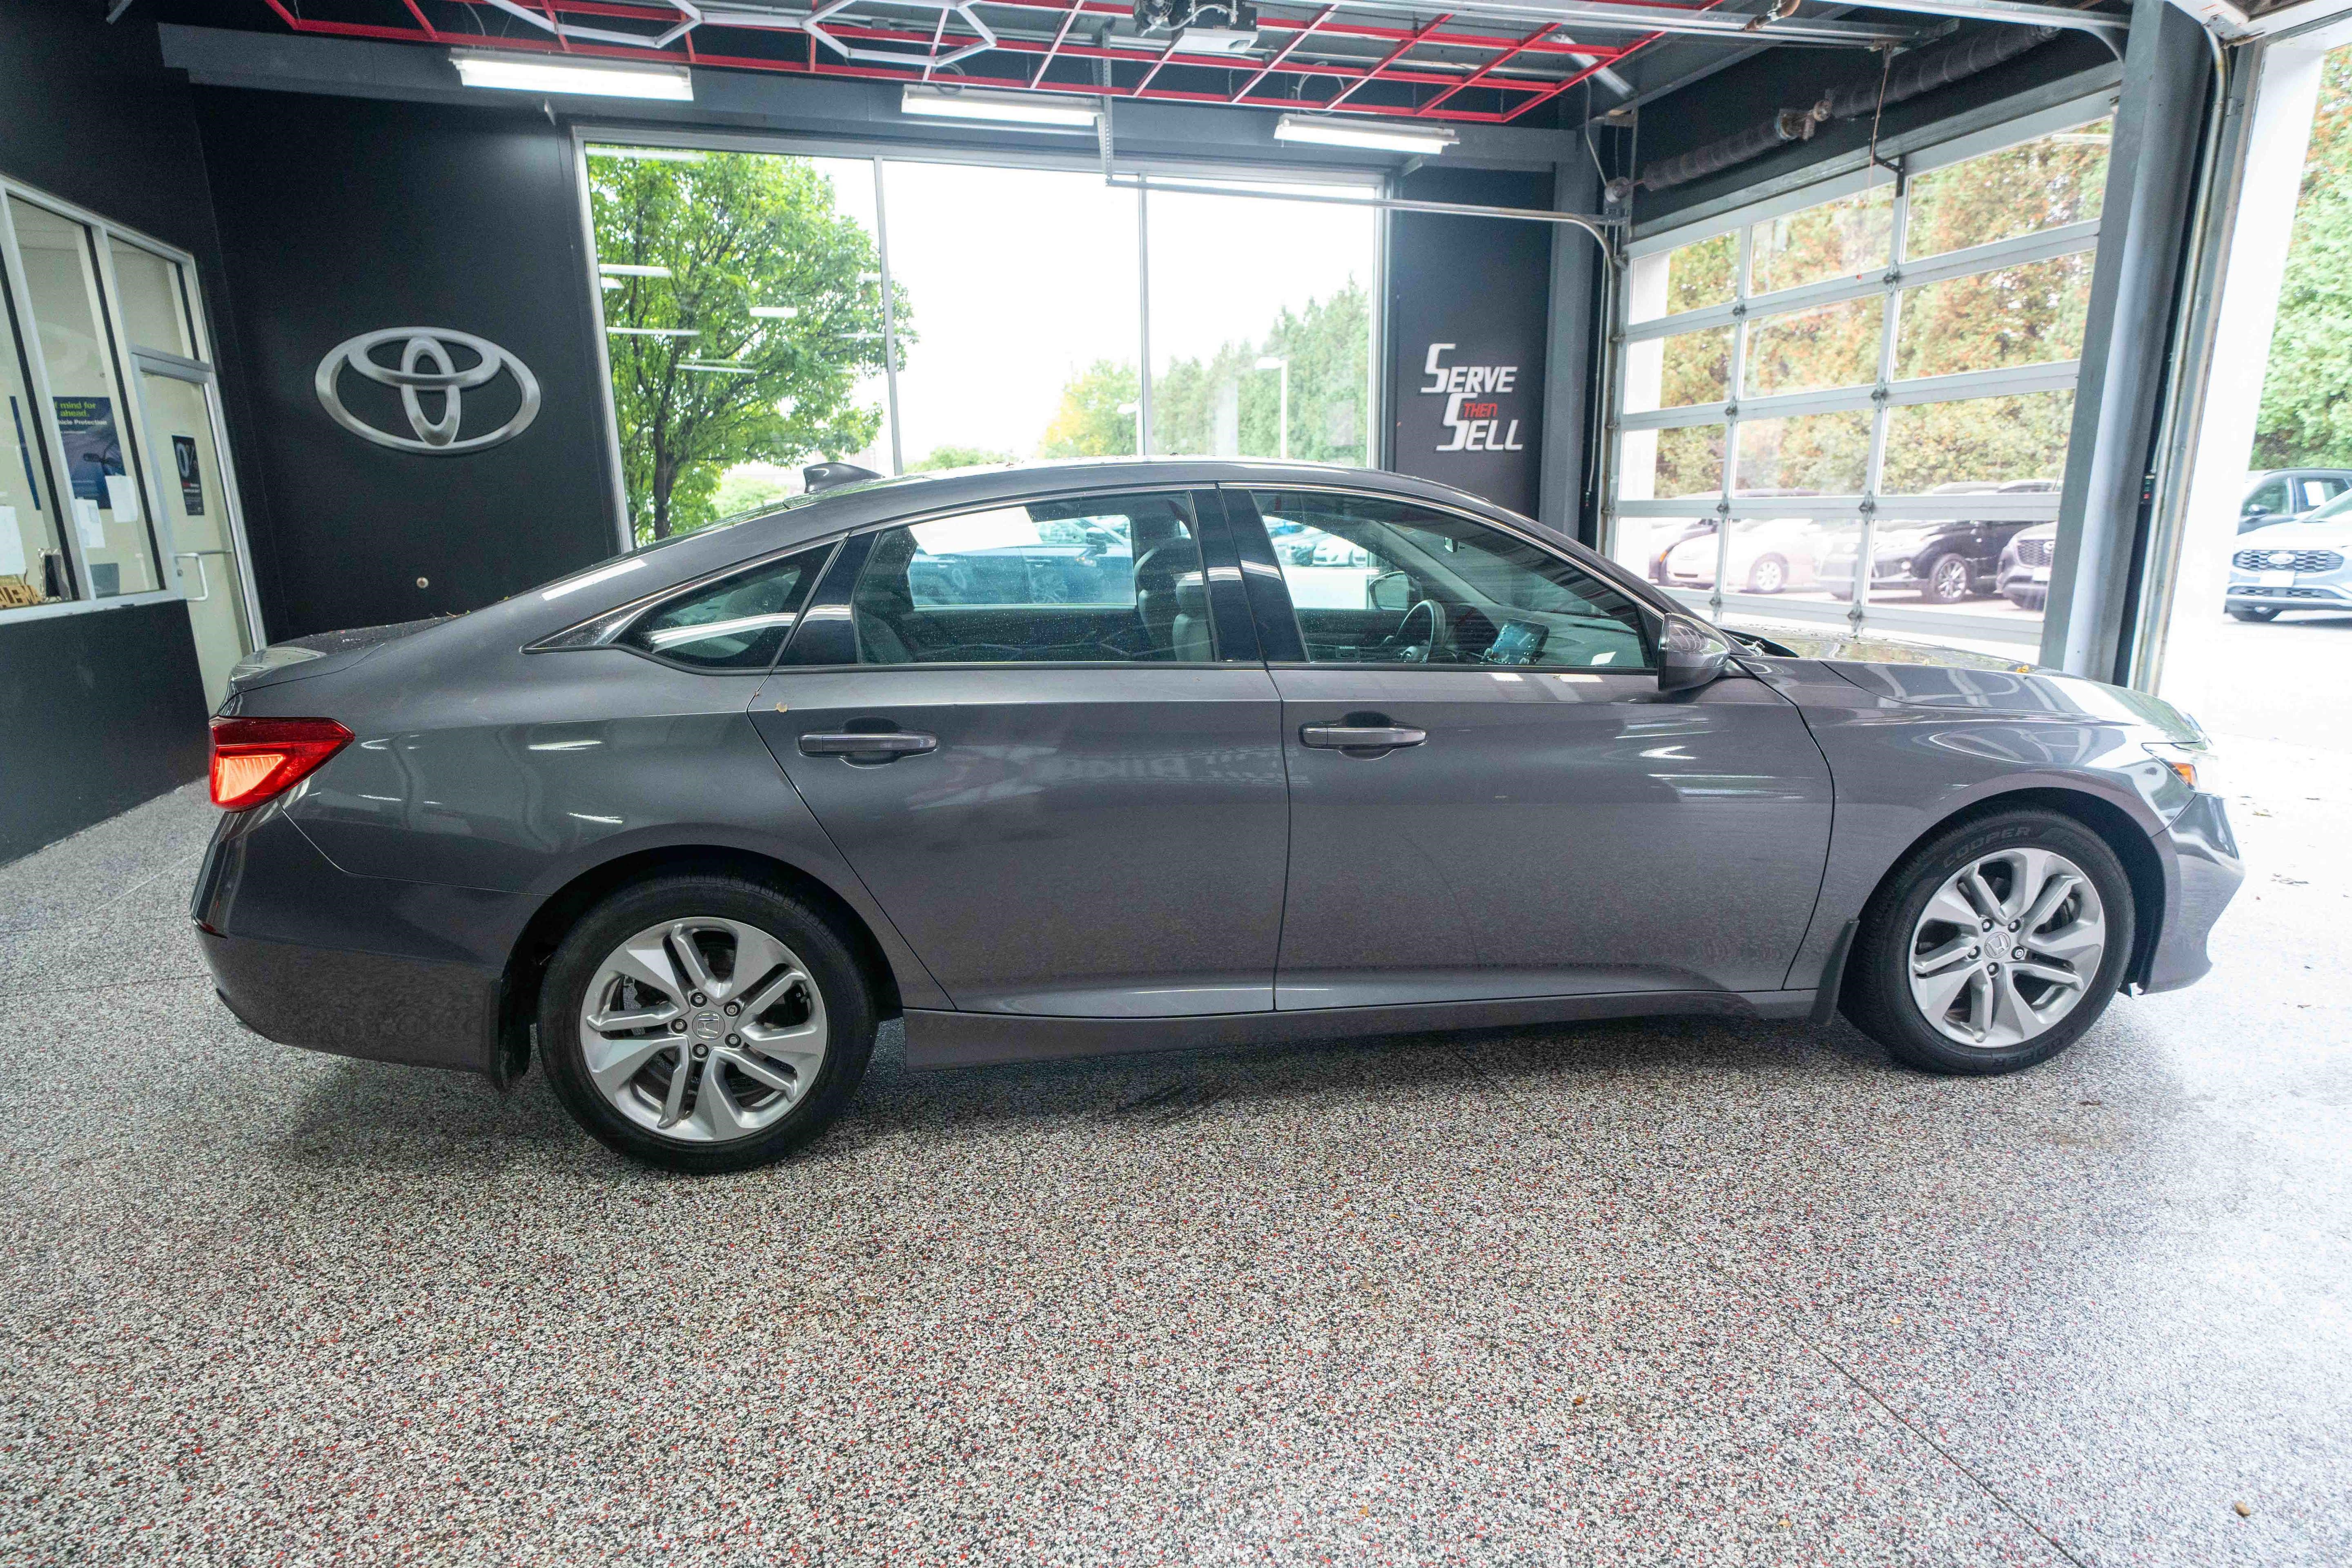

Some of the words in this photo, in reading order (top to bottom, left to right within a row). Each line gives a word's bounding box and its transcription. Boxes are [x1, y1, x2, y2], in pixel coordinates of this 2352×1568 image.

[1421, 343, 1518, 394] SERVE
[1436, 392, 1524, 452] SELL
[1463, 402, 1498, 419] THEN
[1943, 826, 2031, 869] COOPER
